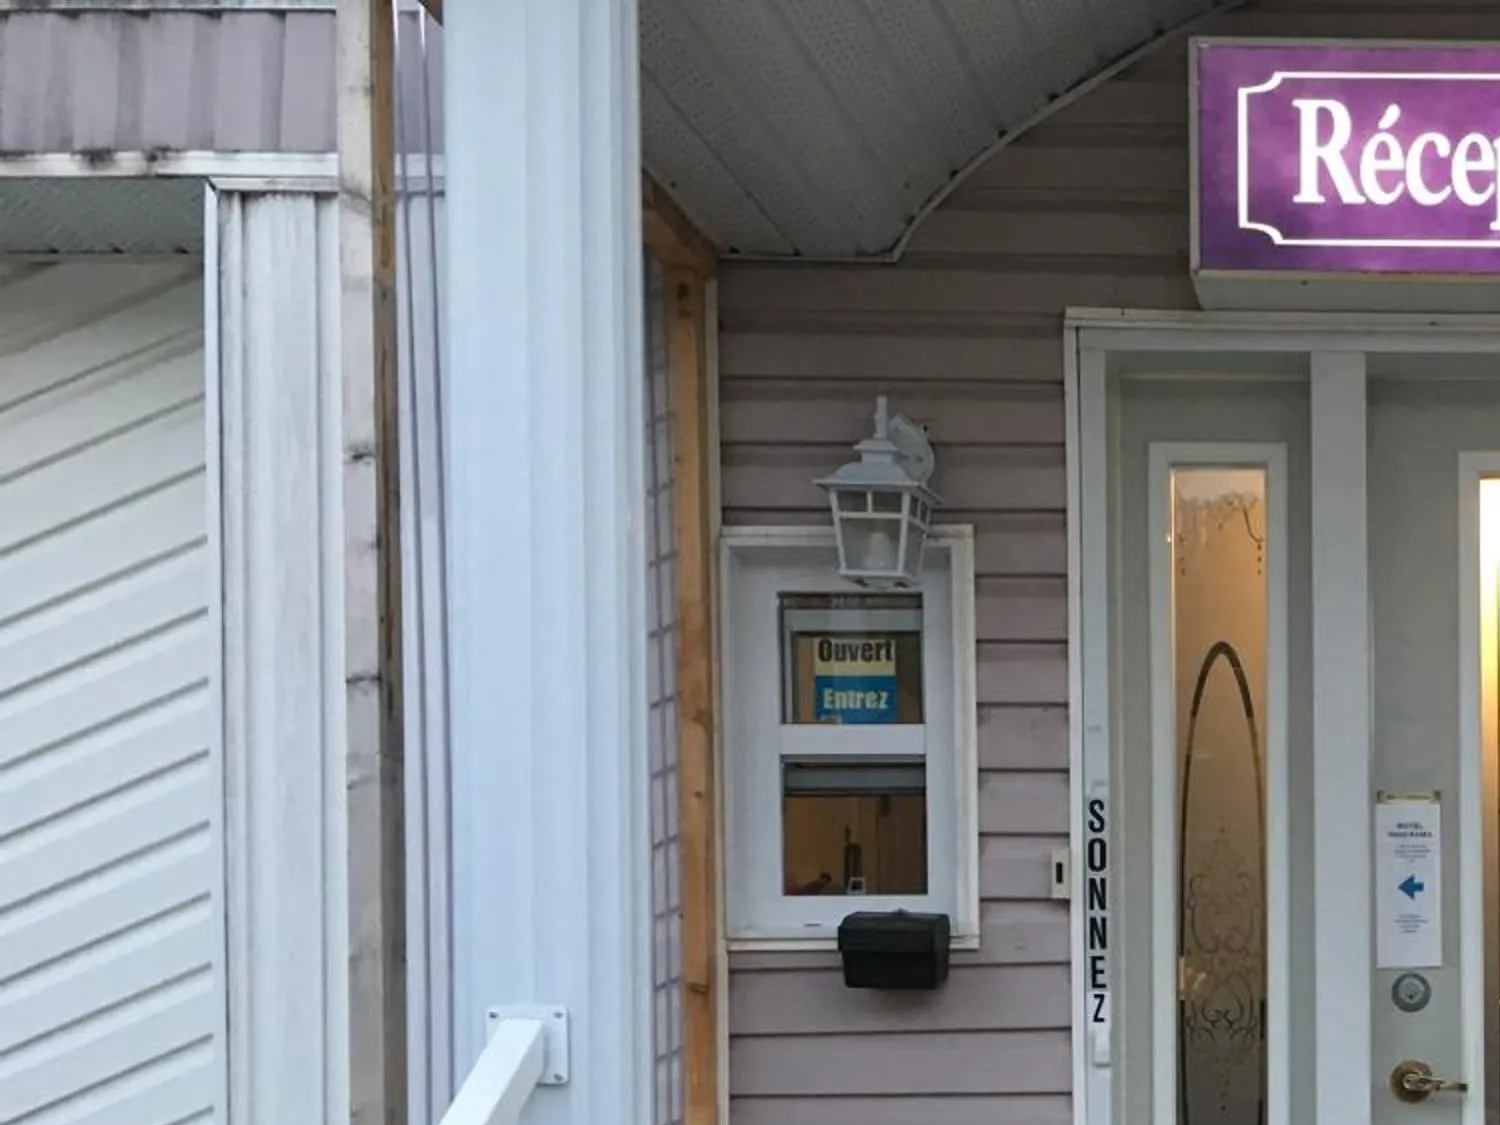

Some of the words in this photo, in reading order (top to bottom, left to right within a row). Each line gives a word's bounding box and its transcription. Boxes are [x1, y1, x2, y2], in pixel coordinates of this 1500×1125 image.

[818, 638, 892, 662] Ouvert
[822, 687, 889, 709] Entrez
[1087, 799, 1108, 1023] SONNEZ
